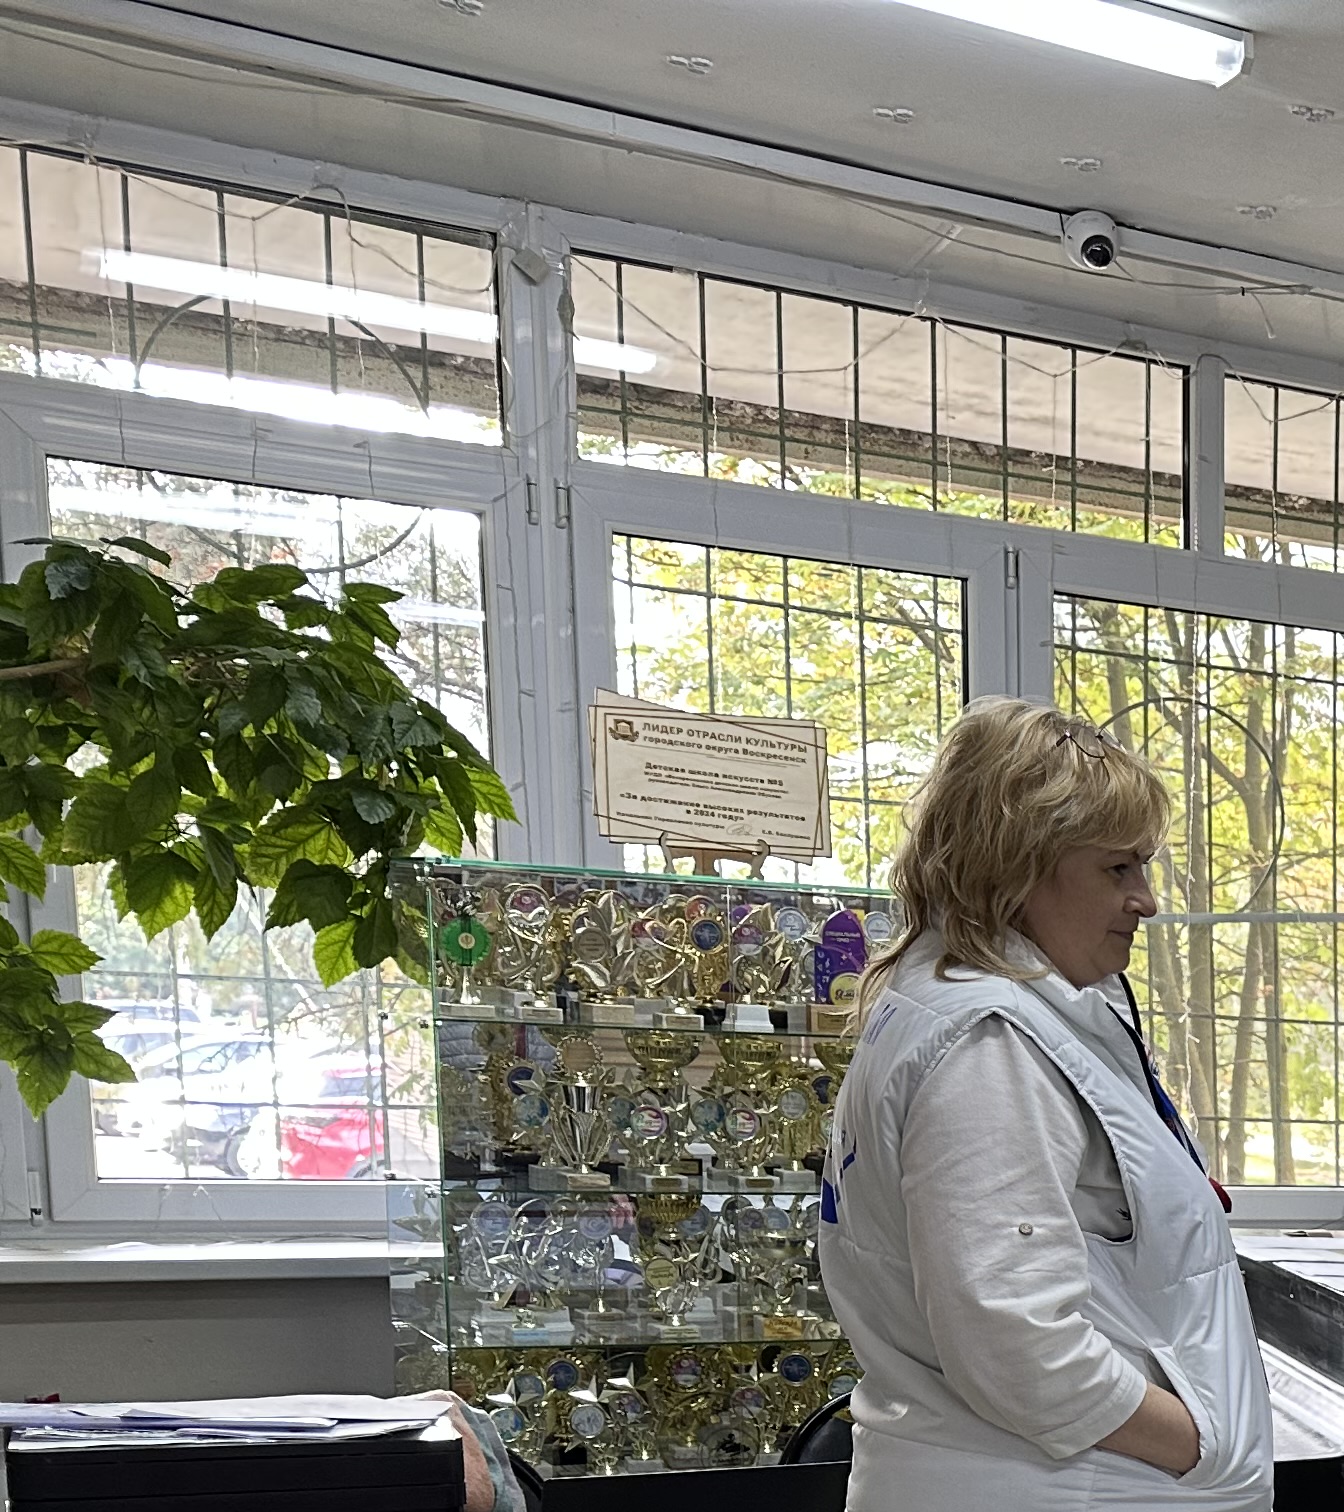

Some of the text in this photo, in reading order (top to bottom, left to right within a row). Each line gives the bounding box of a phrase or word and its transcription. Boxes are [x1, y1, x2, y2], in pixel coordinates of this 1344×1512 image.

[642, 722, 807, 753] ЛИДЕР ОТРАСЛИ КУЛЬТУРЫ
[643, 736, 807, 764] городского округа Воскресенск
